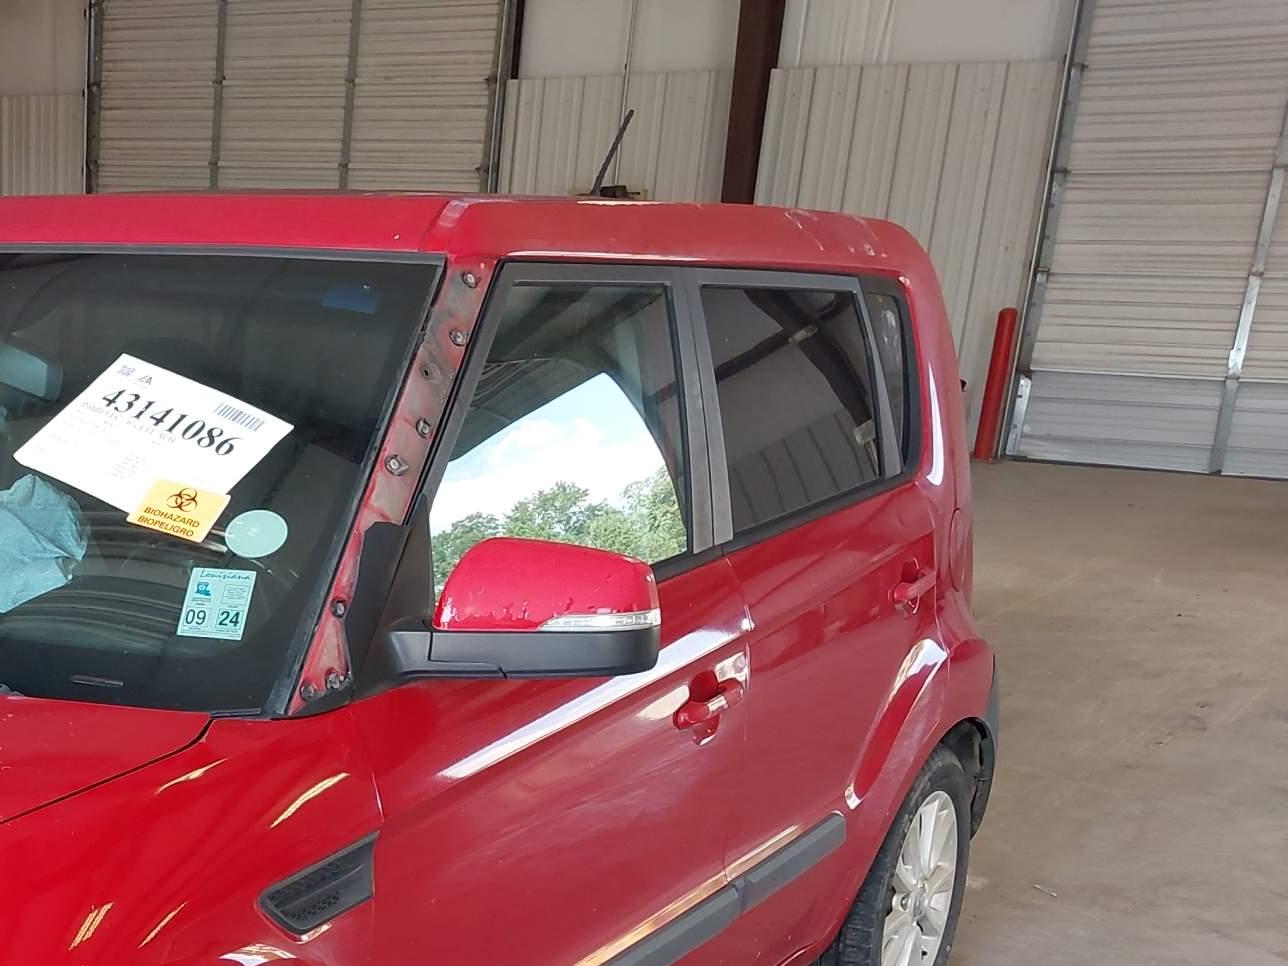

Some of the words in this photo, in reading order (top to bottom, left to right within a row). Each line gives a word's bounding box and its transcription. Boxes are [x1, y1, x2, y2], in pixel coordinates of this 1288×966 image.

[101, 389, 241, 456] 43141086
[137, 515, 194, 538] BIOPELIGRO
[143, 506, 200, 528] BIOHAZARD
[199, 568, 251, 581] Louisiana
[185, 608, 207, 626] 09
[218, 610, 241, 628] 24
